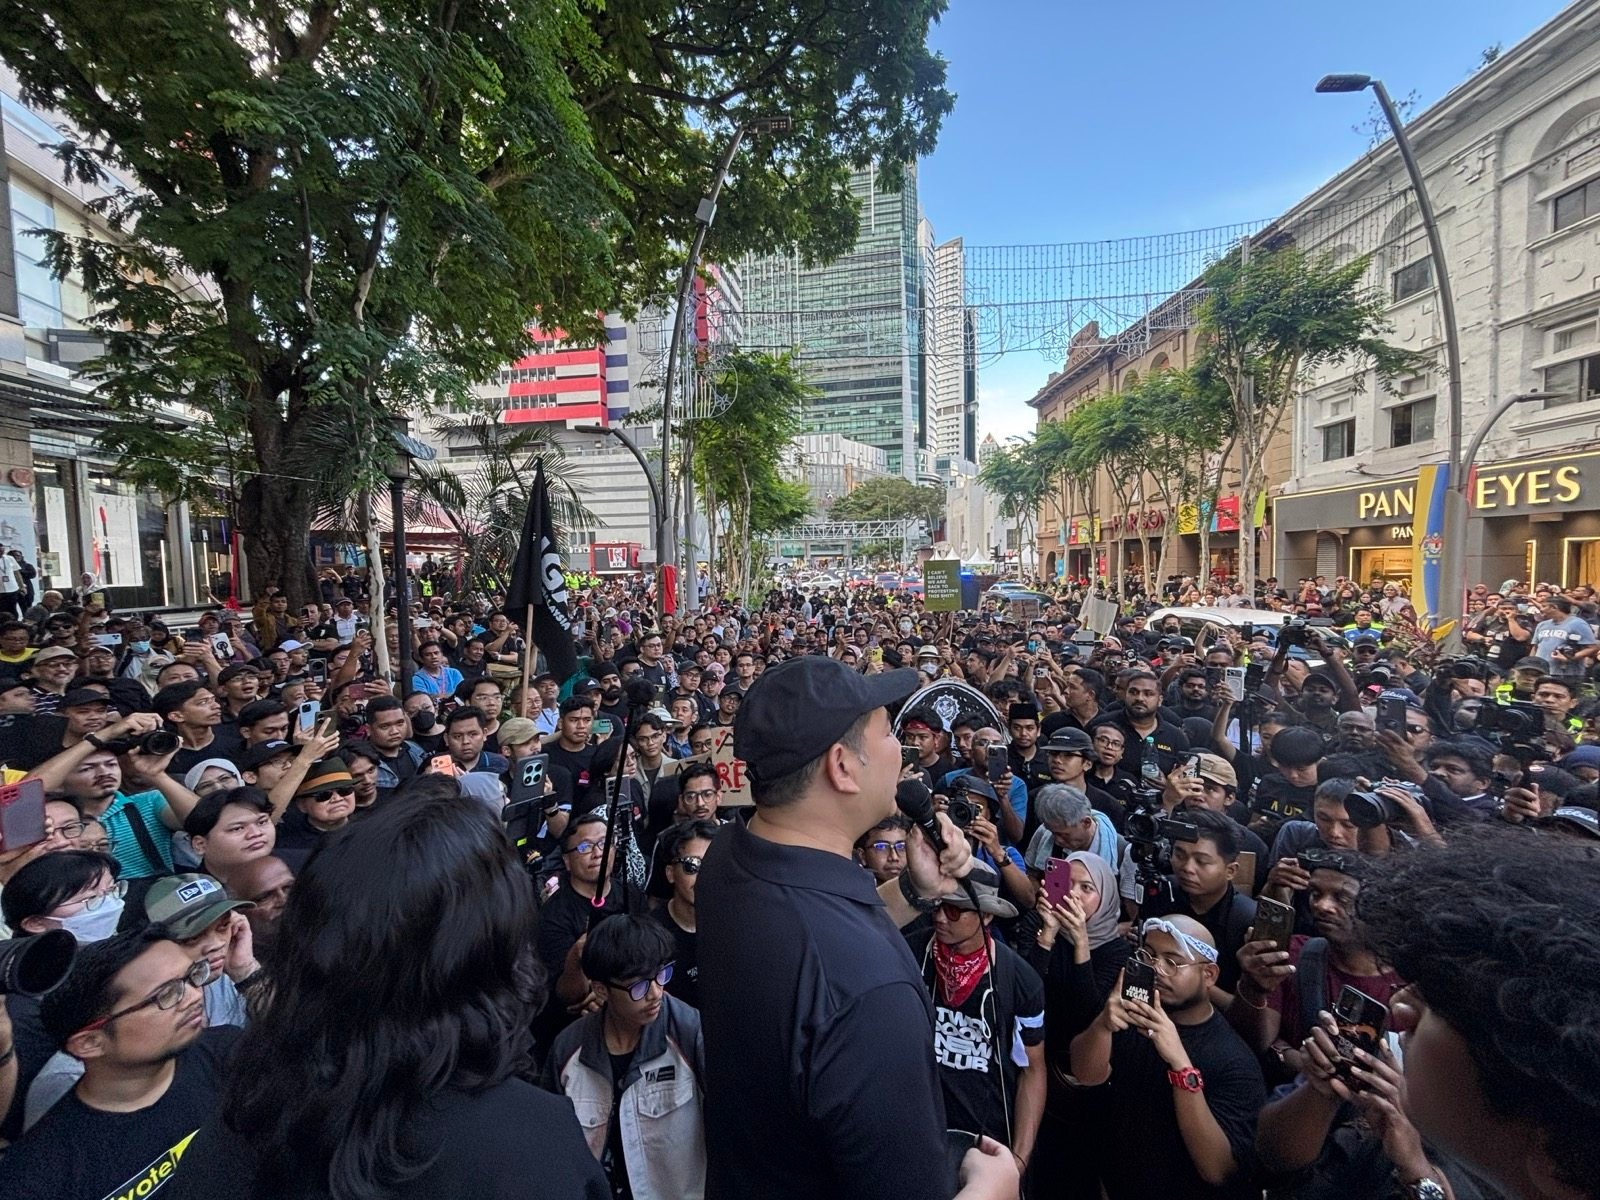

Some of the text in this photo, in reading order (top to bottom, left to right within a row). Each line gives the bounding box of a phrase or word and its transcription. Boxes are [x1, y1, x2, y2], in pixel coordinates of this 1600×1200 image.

[1359, 466, 1581, 520] PAN EYES
[1125, 990, 1150, 1003] TEGAK
[1128, 985, 1149, 996] JALAN
[934, 1032, 993, 1060] NEW
